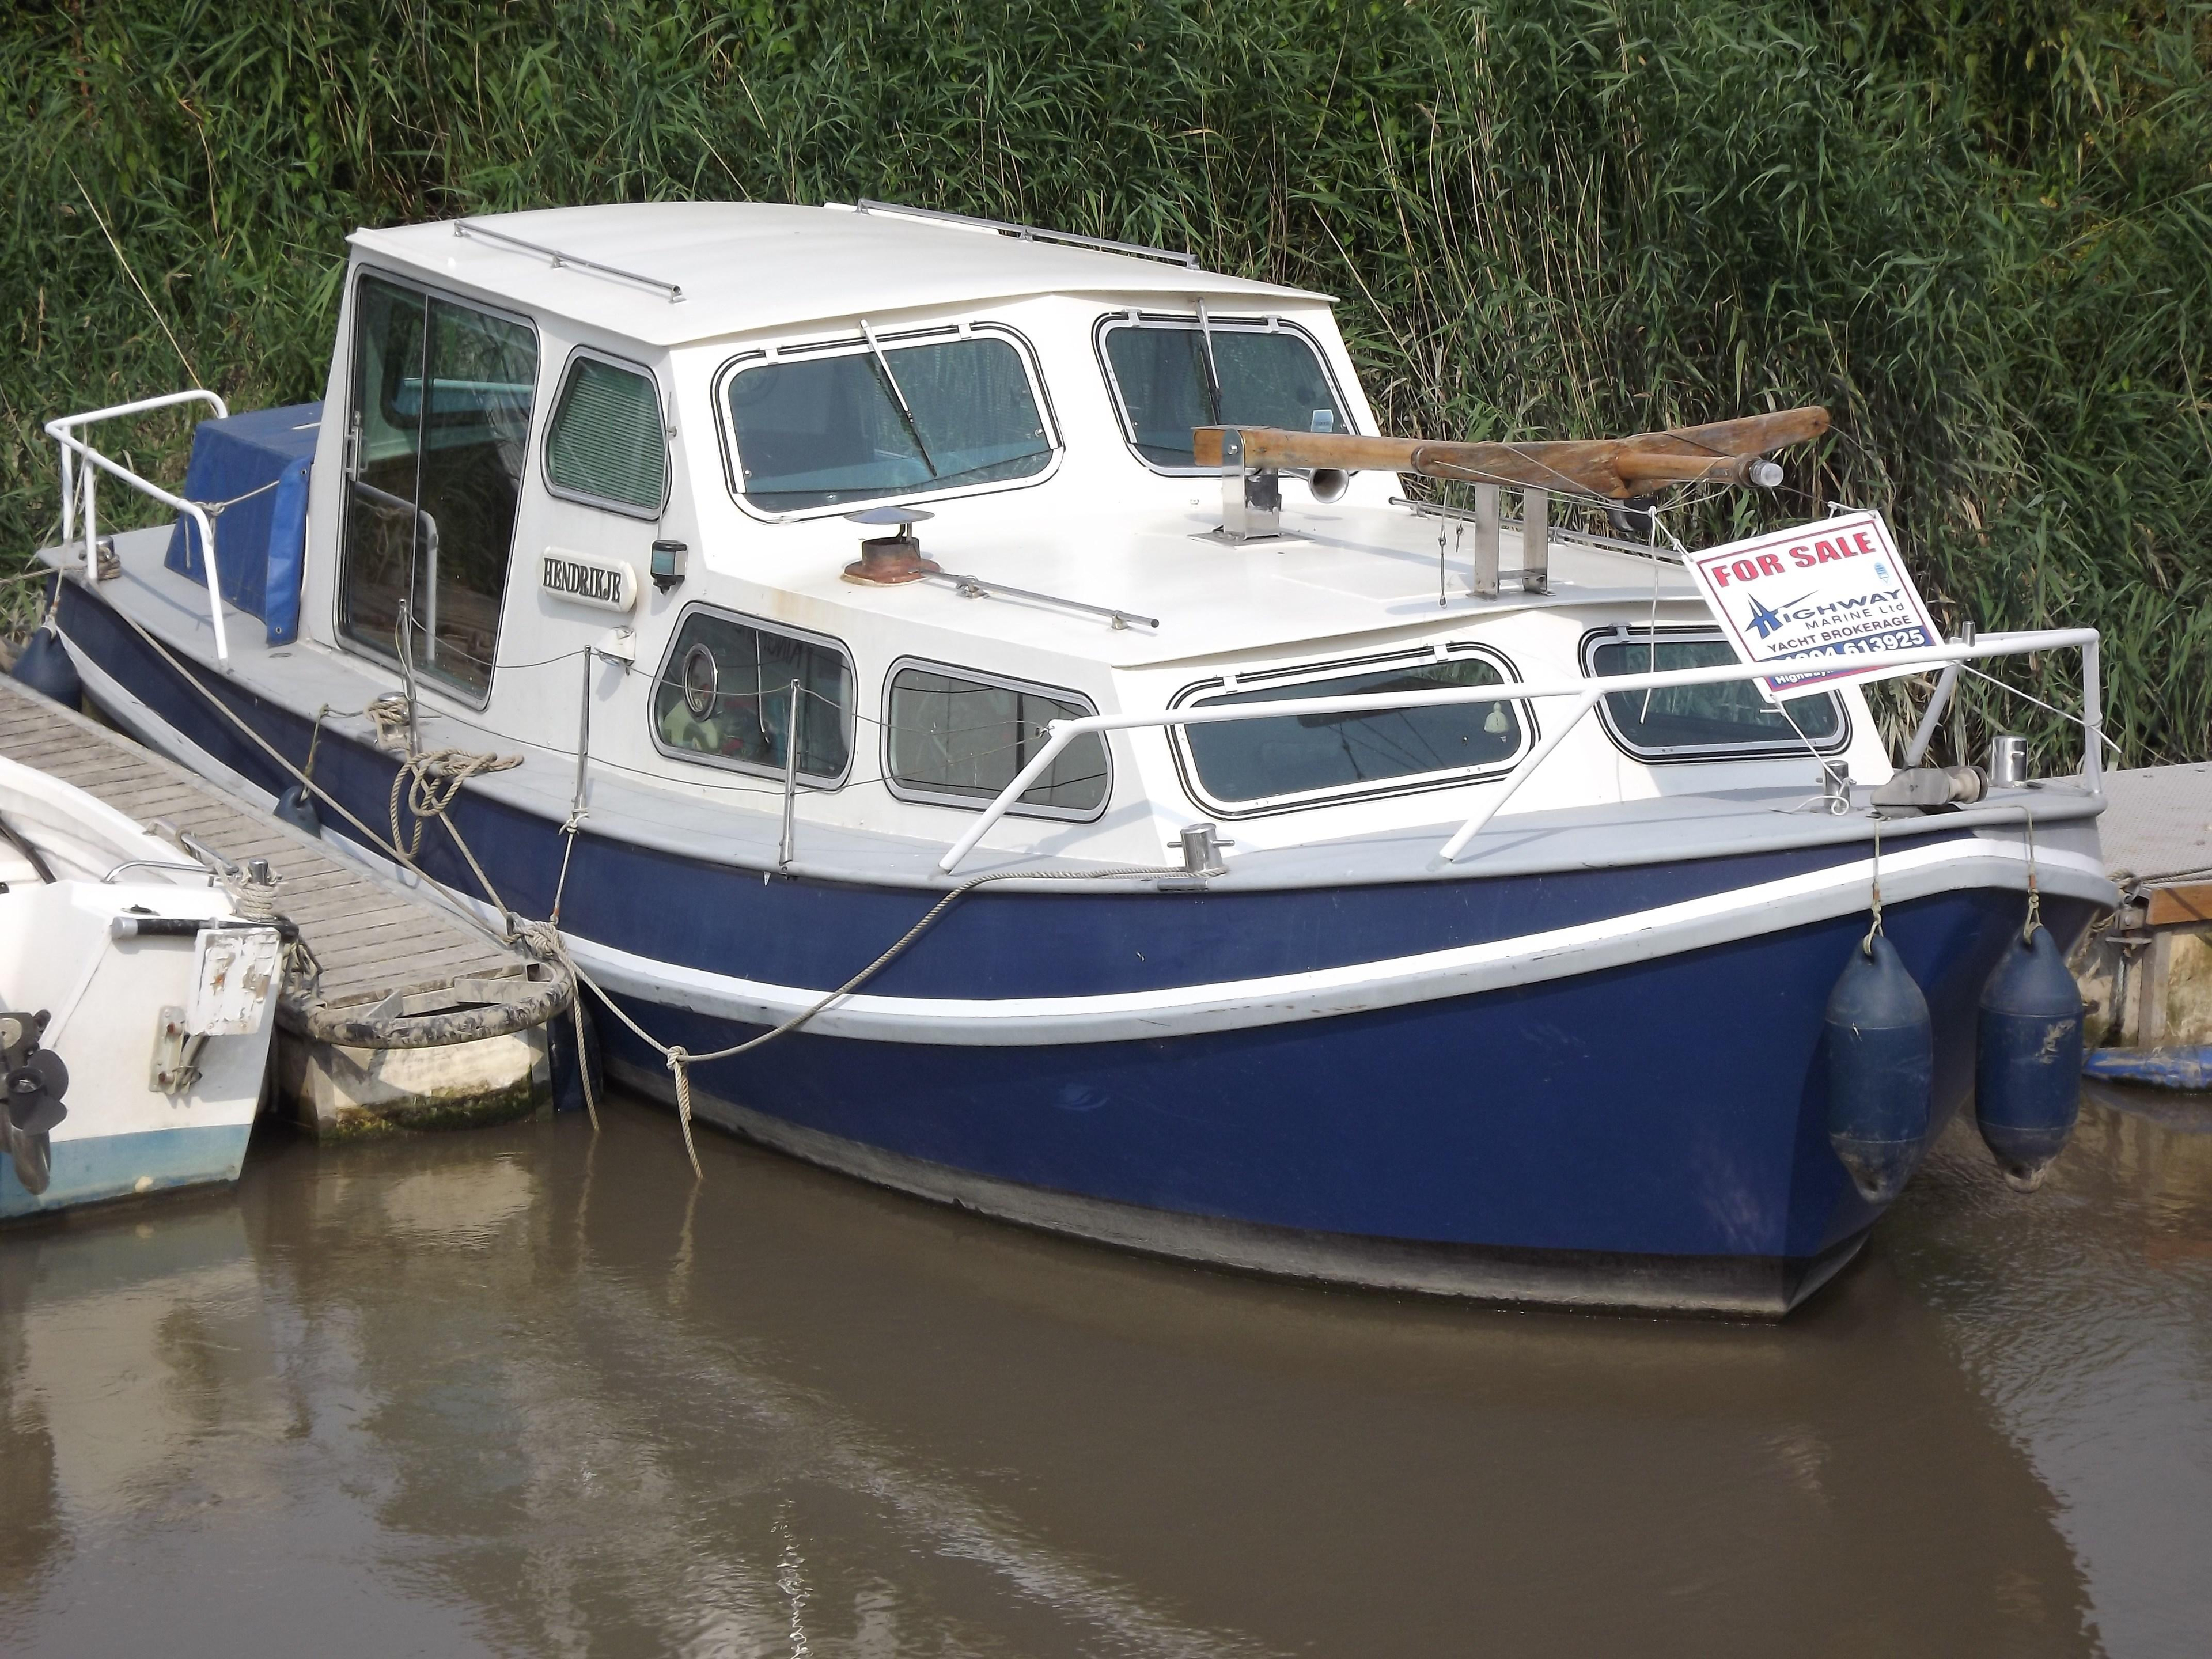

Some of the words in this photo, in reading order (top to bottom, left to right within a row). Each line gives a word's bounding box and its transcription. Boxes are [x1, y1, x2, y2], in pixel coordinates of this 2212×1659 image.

[543, 557, 622, 603] HENDRIKJE
[1711, 554, 1785, 588] FOR
[1789, 532, 1876, 568] SALE
[1745, 589, 1901, 639] HIGHWAY
[1767, 635, 1816, 653] YACHT
[1821, 615, 1912, 641] BROKERAGE
[1805, 608, 1872, 630] MARINE
[1879, 603, 1904, 614] Ltd
[1843, 629, 1926, 655] 613925
